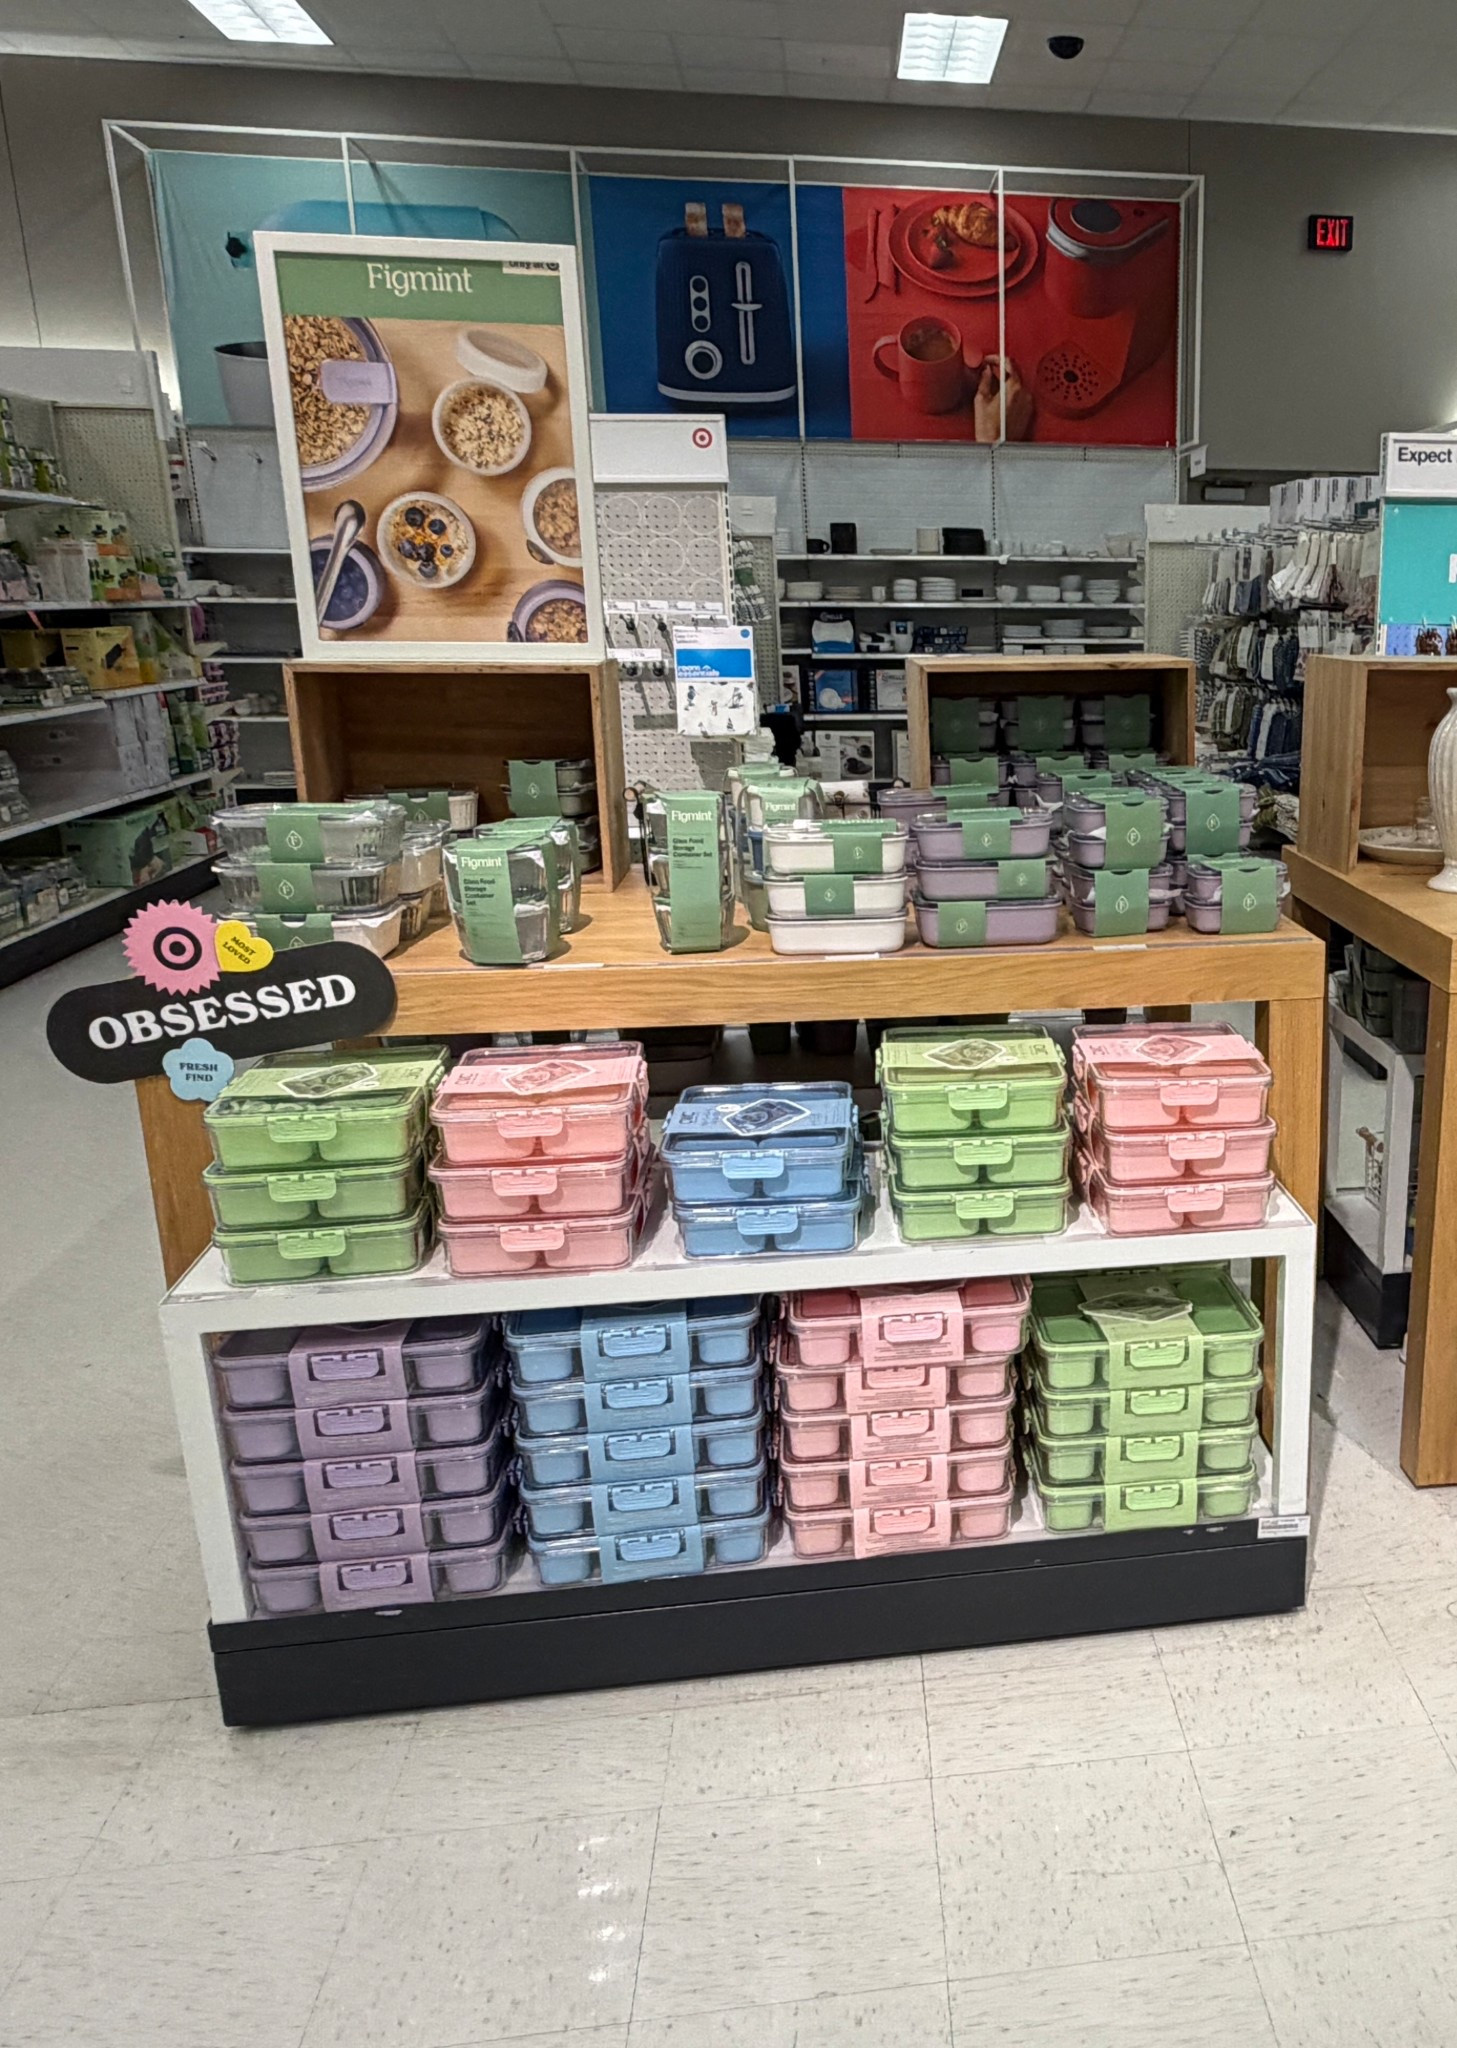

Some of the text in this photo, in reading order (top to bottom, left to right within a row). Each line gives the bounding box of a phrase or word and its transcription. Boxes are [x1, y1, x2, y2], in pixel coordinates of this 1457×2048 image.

[1316, 218, 1349, 246] EXIT
[367, 263, 473, 297] Figmint
[1398, 447, 1452, 466] Expect
[765, 802, 796, 811] Figmint
[671, 810, 712, 823] Figmint
[461, 857, 502, 870] Figmint
[222, 941, 251, 964] LOVED
[231, 936, 256, 955] MOST
[88, 974, 356, 1050] OBSESSED
[179, 1062, 218, 1072] FRESH
[185, 1073, 213, 1082] FIND
